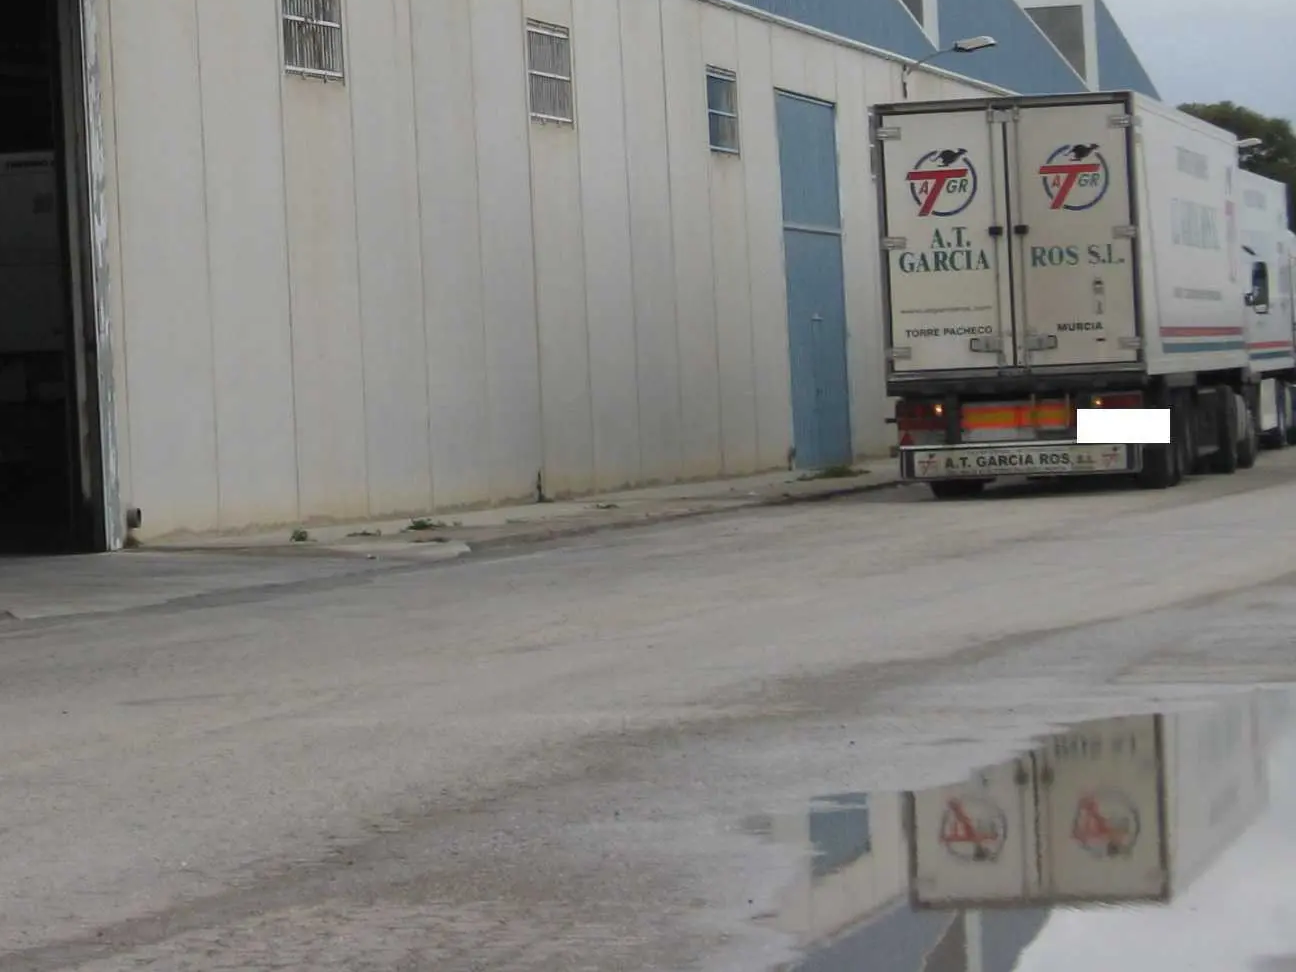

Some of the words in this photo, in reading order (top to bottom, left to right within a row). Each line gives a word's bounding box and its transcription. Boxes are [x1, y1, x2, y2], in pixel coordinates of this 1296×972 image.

[931, 226, 971, 249] A.T.
[899, 249, 991, 273] GARCIA
[1031, 245, 1079, 267] ROS
[1088, 243, 1126, 265] S.L.
[906, 328, 940, 338] TORRE
[943, 325, 993, 336] PACHECO
[1057, 322, 1103, 332] MURCIA
[944, 456, 971, 469] A.T.
[976, 452, 1034, 468] GARCIA
